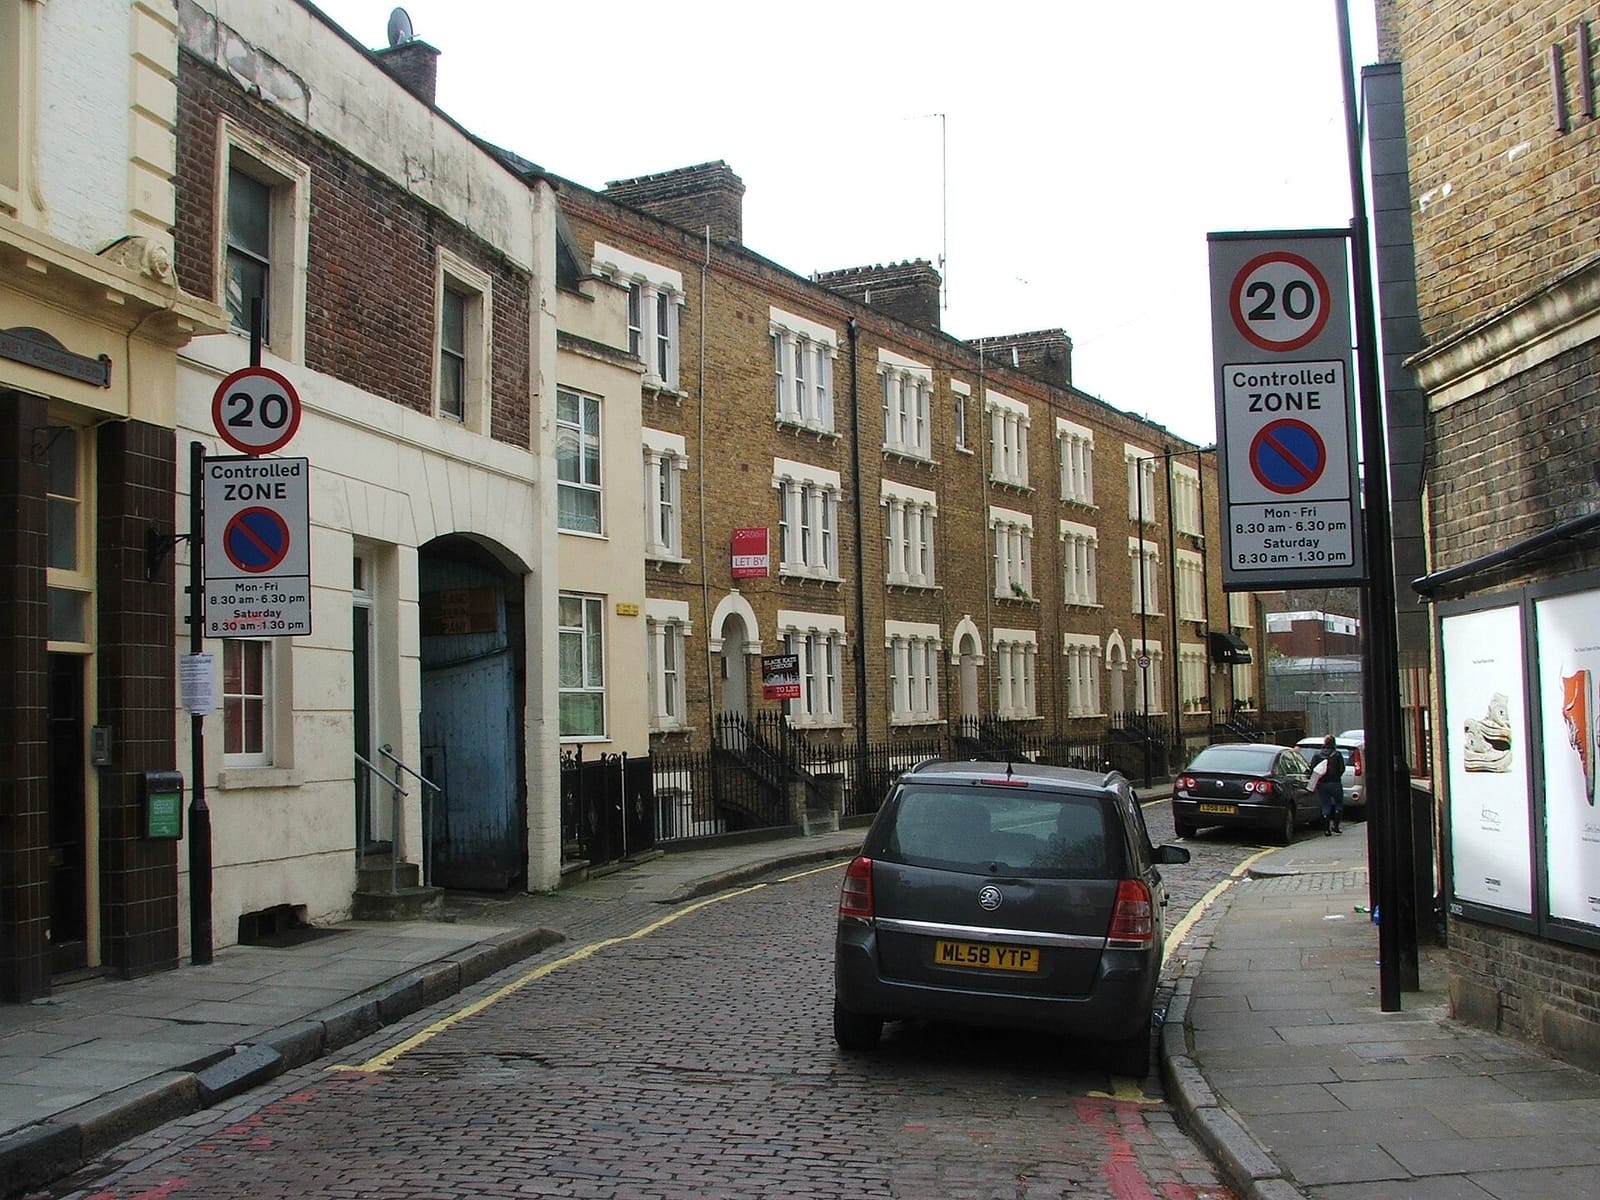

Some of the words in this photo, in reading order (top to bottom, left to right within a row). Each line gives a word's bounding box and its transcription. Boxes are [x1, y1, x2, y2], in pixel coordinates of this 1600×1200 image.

[1246, 280, 1315, 321] 20
[1232, 368, 1336, 388] Controlled
[1248, 391, 1321, 412] ZONE
[227, 392, 288, 429] 20
[211, 463, 300, 479] Controlled
[224, 483, 287, 501] ZONE
[1264, 508, 1290, 519] Mon
[1301, 507, 1317, 517] Fri
[1235, 523, 1265, 534] 8.30
[1268, 524, 1286, 533] am
[1295, 520, 1325, 531] 6.30
[1328, 521, 1347, 532] pm
[1263, 537, 1320, 549] Saturday
[735, 557, 751, 567] LET
[753, 556, 765, 566] BY
[1238, 553, 1268, 564] 8.30
[1270, 554, 1288, 563] am
[1298, 551, 1325, 562] 1.30
[1328, 551, 1347, 562] pm
[210, 595, 236, 605] 8.30
[289, 594, 305, 604] pm
[233, 609, 282, 618] Saturday
[211, 622, 237, 632] 8.30
[288, 621, 304, 631] pm
[785, 685, 799, 693] LET
[942, 943, 990, 964] ML58
[996, 949, 1031, 967] YTP
